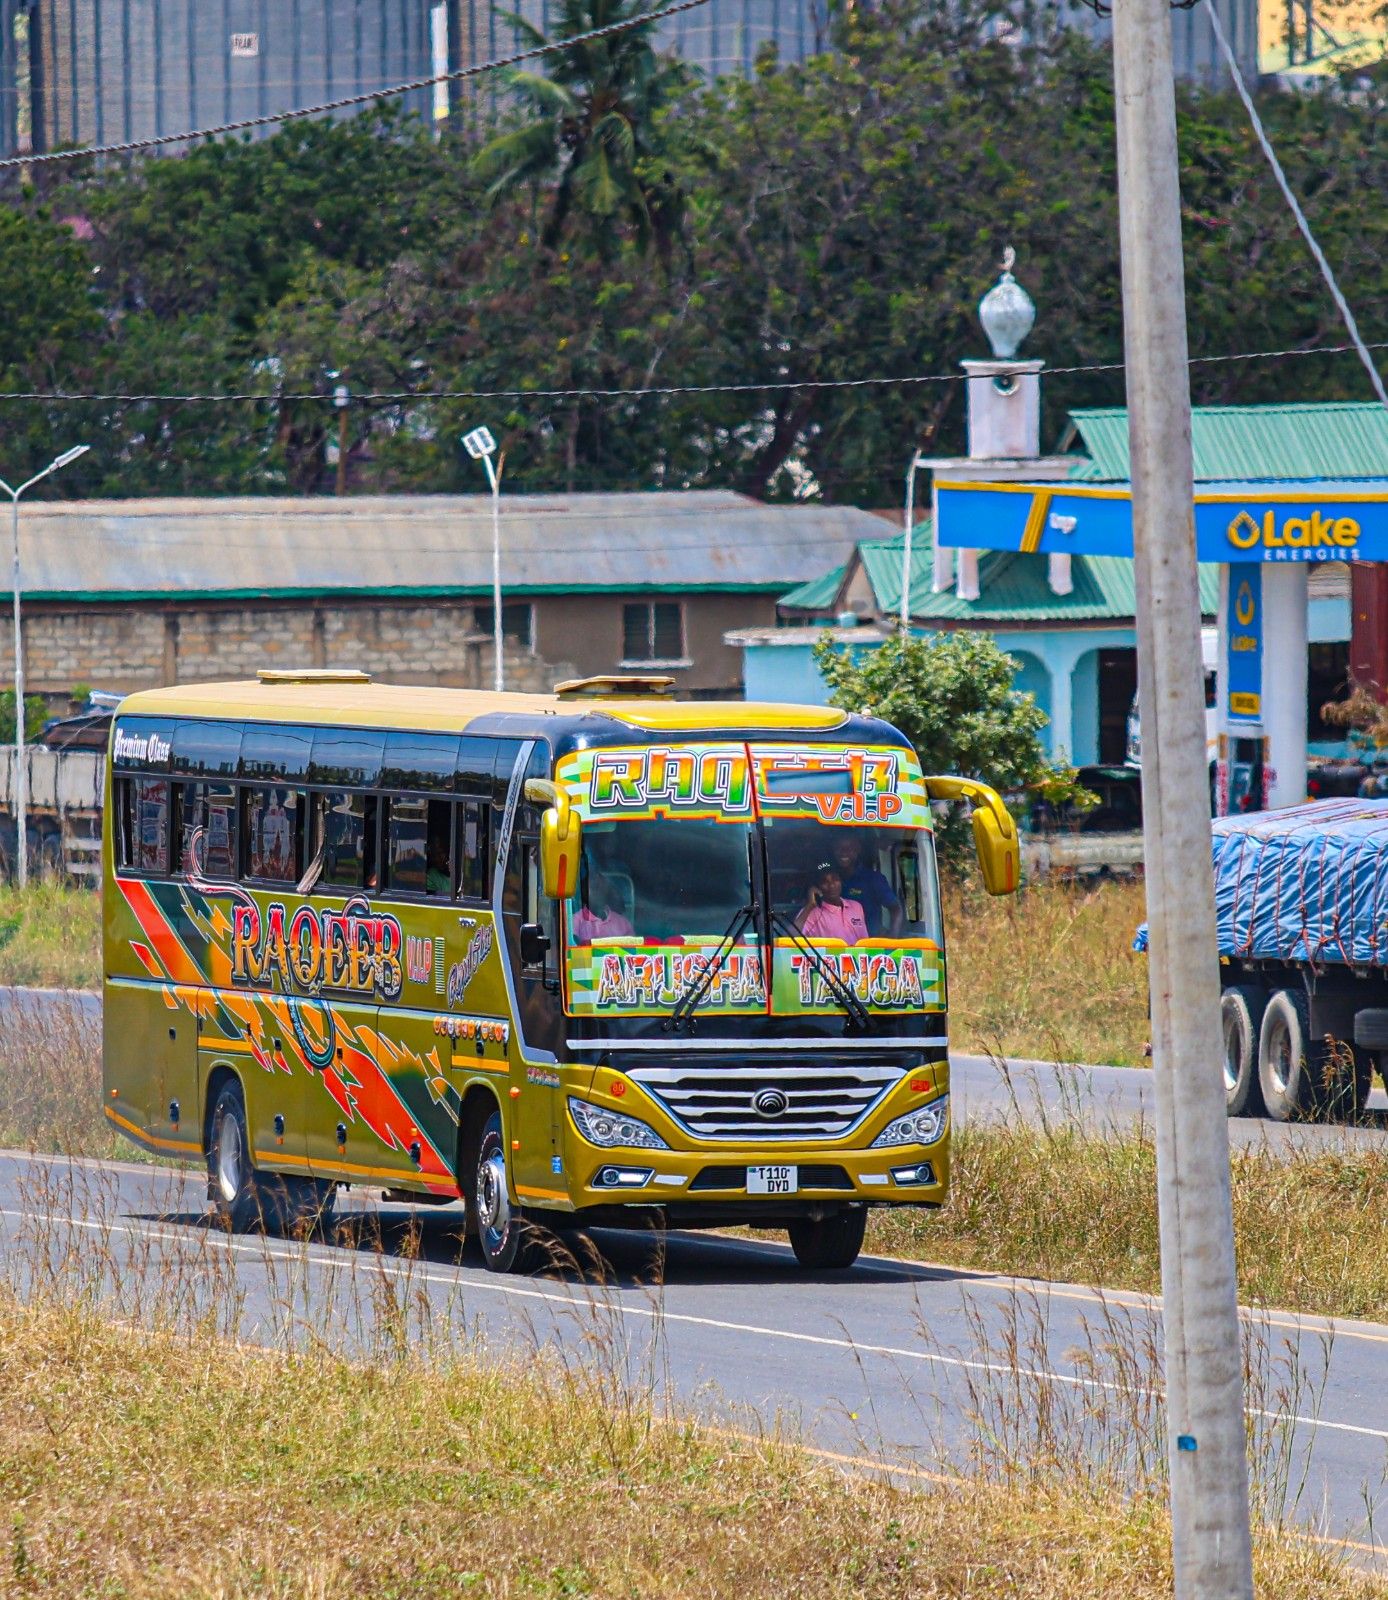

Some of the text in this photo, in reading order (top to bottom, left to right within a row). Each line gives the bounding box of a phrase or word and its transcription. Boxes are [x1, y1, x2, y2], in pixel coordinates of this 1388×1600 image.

[1263, 510, 1361, 548] Lake
[1263, 548, 1360, 561] ENERGIES
[113, 727, 170, 763] Premium Class
[818, 793, 903, 822] V.I.P
[231, 895, 403, 1001] RAQEEB
[596, 953, 924, 1006] ARUSHA TANGA
[758, 1167, 788, 1180] T110
[767, 1180, 790, 1193] DYD
